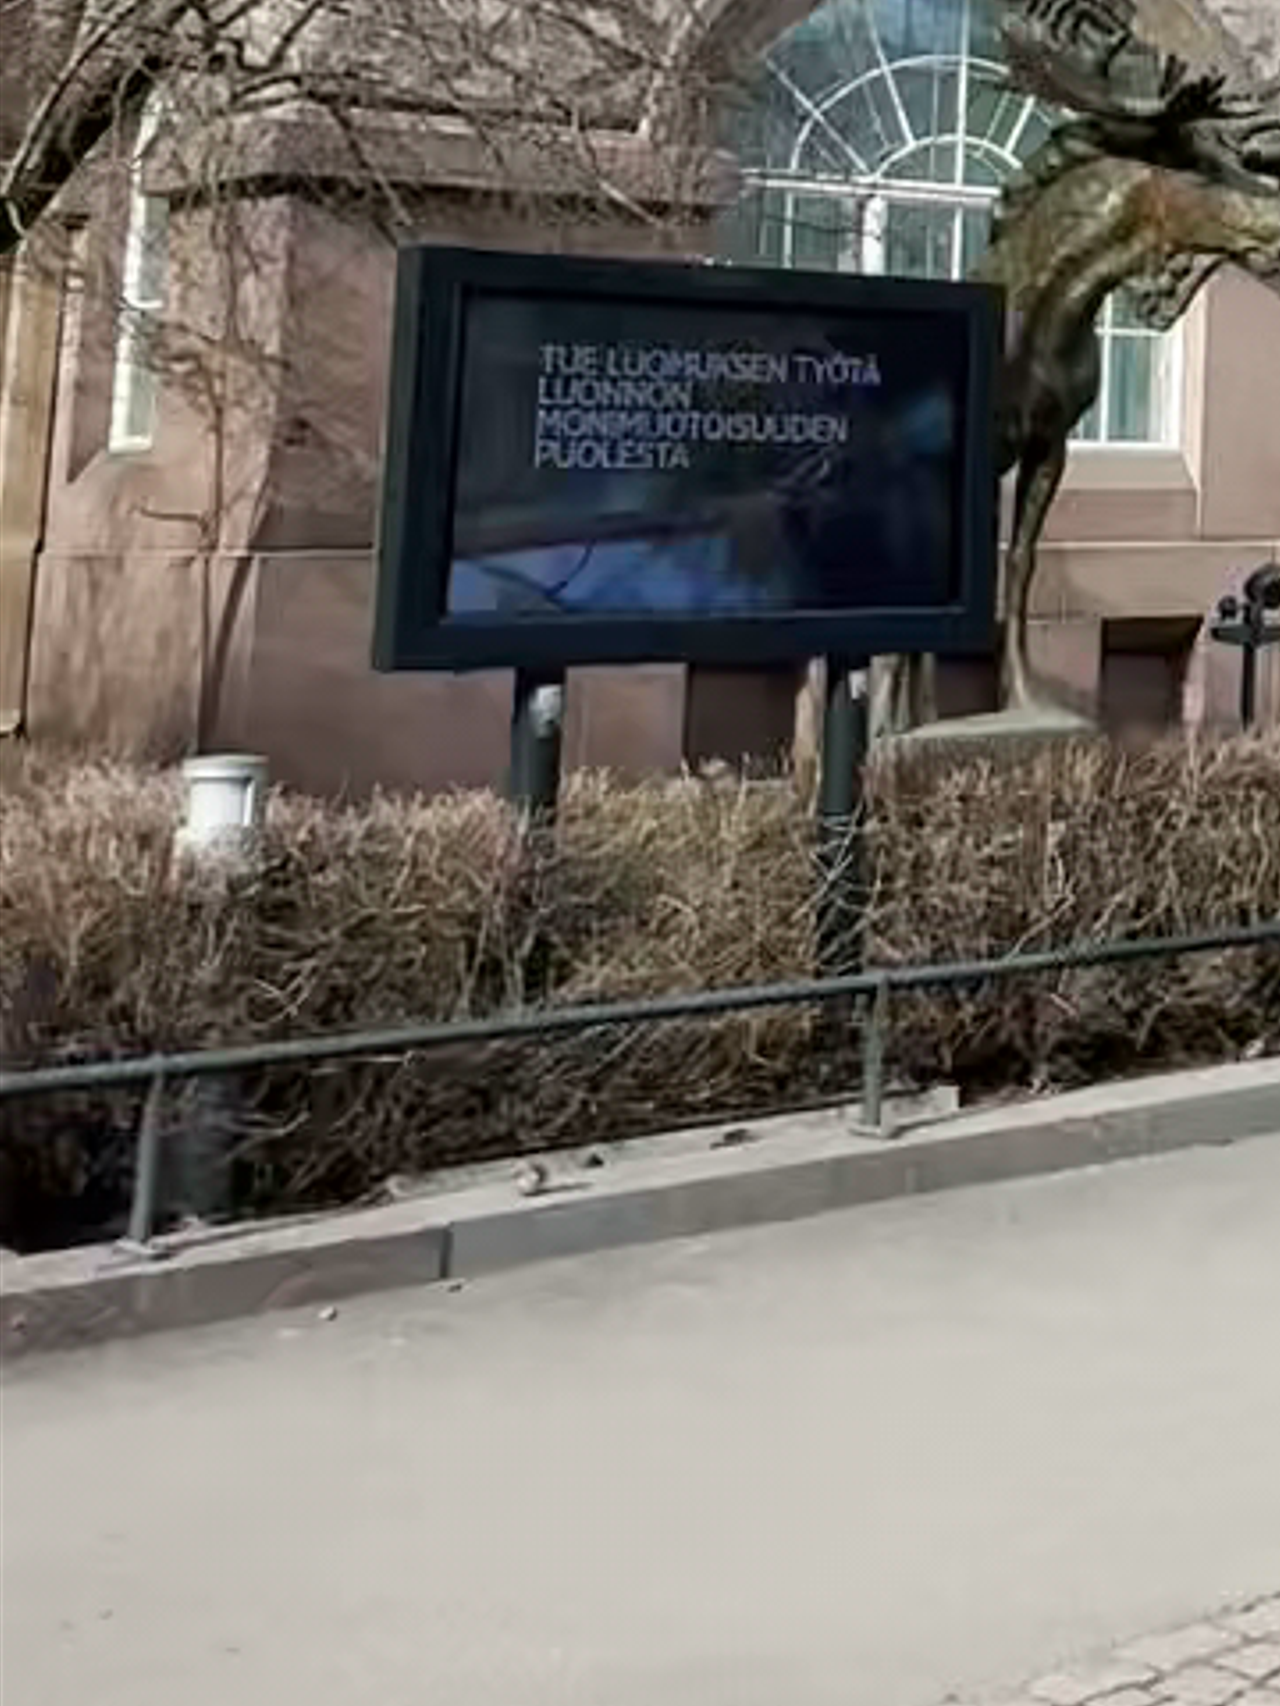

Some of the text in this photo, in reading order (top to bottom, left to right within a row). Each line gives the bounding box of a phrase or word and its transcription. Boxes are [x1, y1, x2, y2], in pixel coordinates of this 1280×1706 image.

[539, 345, 599, 376] TUE
[538, 375, 693, 409] LUONNON
[535, 438, 690, 469] PUOLESTA
